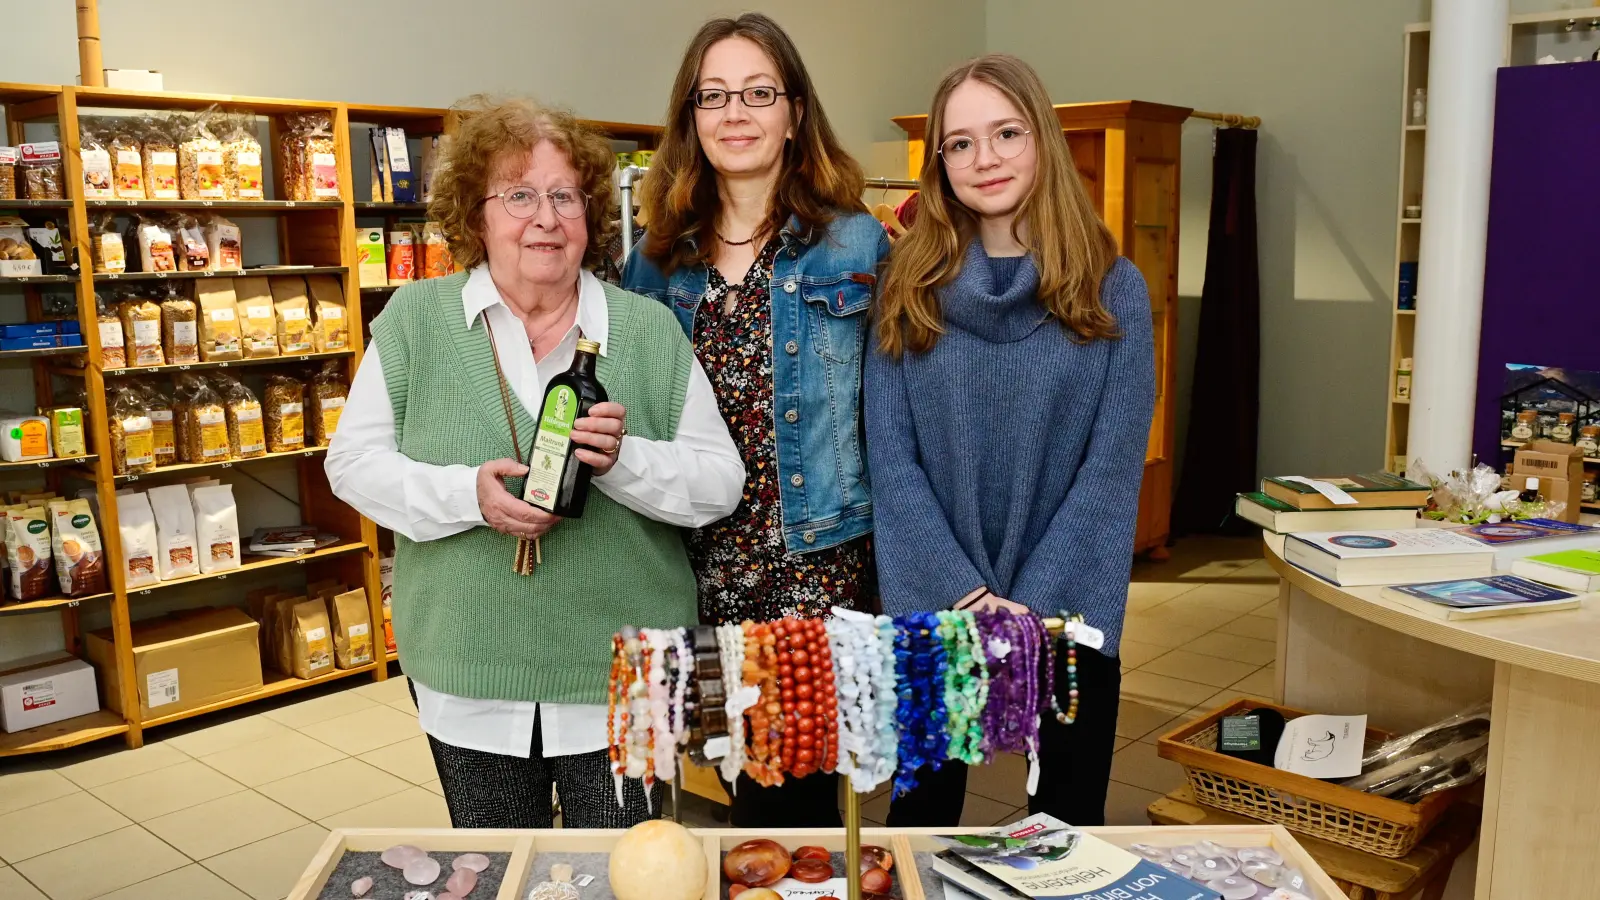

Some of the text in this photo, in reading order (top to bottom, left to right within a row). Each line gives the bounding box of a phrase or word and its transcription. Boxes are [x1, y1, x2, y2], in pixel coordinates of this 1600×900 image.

[539, 435, 565, 448] Maitrunk
[1021, 866, 1112, 890] Heilsteine
[1125, 873, 1167, 892] von
